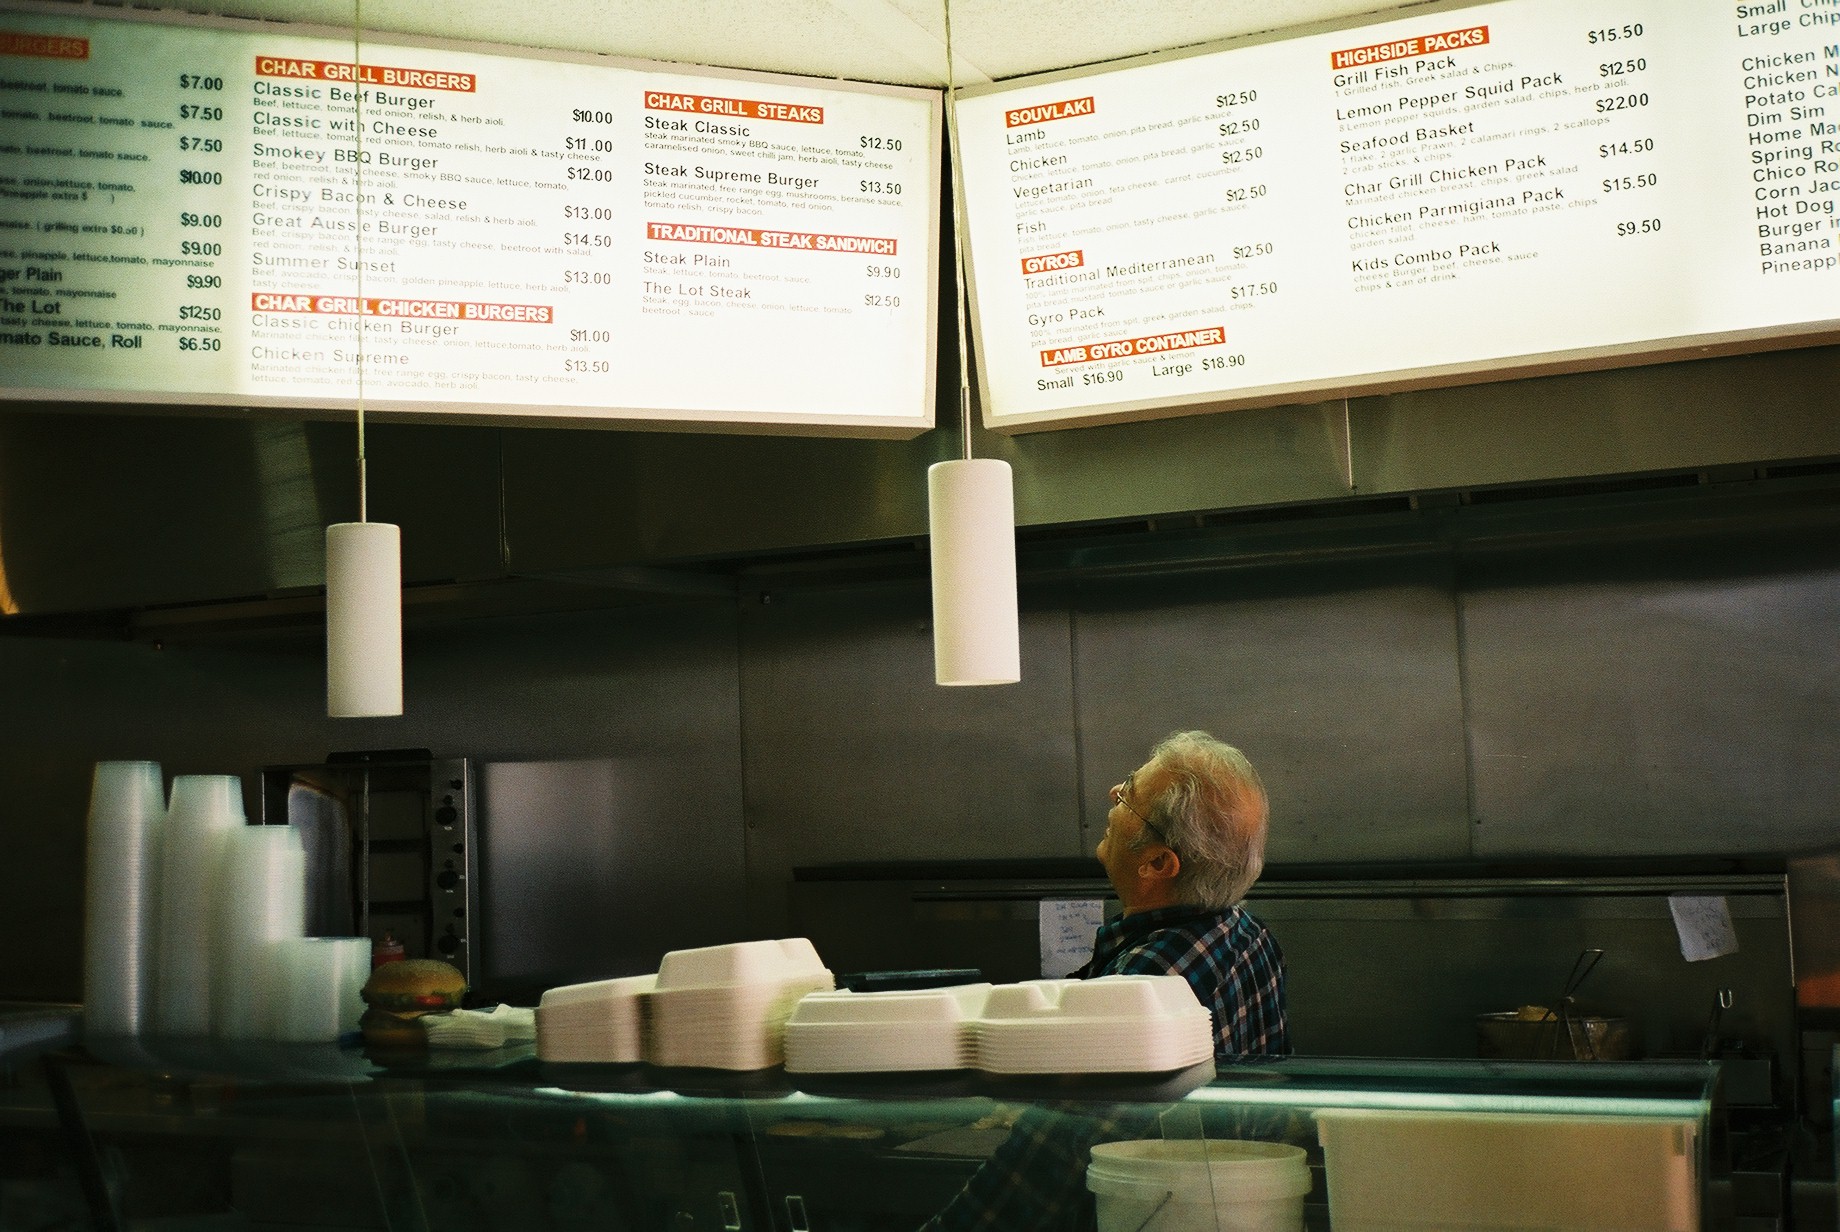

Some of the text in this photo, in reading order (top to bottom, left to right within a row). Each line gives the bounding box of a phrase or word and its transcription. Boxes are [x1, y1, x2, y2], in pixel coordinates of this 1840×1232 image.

[1736, 0, 1786, 19] Small
[1588, 24, 1644, 45] $15.50
[1738, 20, 1791, 37] Large
[1336, 29, 1484, 68] HIGHSIDE PACKS
[1742, 52, 1815, 72] Chicken
[261, 60, 471, 91] CHAR GRILL BURGERS
[1334, 56, 1456, 88] Grill Fish Pack
[1744, 70, 1817, 90] Chicken
[180, 74, 224, 91] $7.00
[254, 81, 435, 110] Classic Beef Burger
[1336, 72, 1564, 121] Lemon Pepper Squid Pack
[1596, 93, 1649, 113] $22.00
[1745, 90, 1805, 109] Potato
[180, 105, 223, 121] $7.50
[573, 109, 613, 124] $10.00
[648, 94, 821, 122] CHAR GRILL STEAKS
[1009, 99, 1092, 125] SOUVLAKI
[1747, 106, 1825, 127] Dim Sim
[254, 112, 321, 130] Classic
[373, 121, 437, 138] Cheese
[644, 117, 750, 137] Steak Classic
[1564, 116, 1610, 129] scallops
[180, 136, 223, 153] $7.50
[671, 135, 716, 144] marinated
[718, 138, 746, 148] smoky
[750, 141, 769, 149] BBQ
[860, 136, 902, 151] $12.50
[1006, 129, 1046, 145] Lamb
[1340, 122, 1474, 154] Seafood Basket
[1749, 128, 1802, 145] Home
[254, 143, 438, 170] Smokey BBQ Burger
[1599, 138, 1654, 159] $14.50
[1751, 146, 1813, 166] Spring
[730, 149, 755, 157] sweet
[799, 155, 818, 164] herb
[842, 159, 862, 169] tasty
[865, 161, 893, 170] cheese
[1010, 154, 1068, 173] Chicken
[568, 167, 613, 183] $12.00
[644, 163, 820, 190] Steak Supreme Burger
[1344, 155, 1546, 197] Char Grill Chicken Pack
[1602, 173, 1657, 193] $15.50
[1754, 166, 1806, 182] Chico
[253, 184, 467, 210] Crispy Bacon & Cheese
[860, 180, 902, 195] $13.50
[1013, 177, 1093, 200] Vegetarian
[1755, 186, 1800, 201] Corn
[564, 205, 612, 221] $13.00
[1348, 187, 1565, 230] Chicken Parmigiana Pack
[1756, 200, 1834, 219] Hot Dog
[181, 212, 222, 228] $9.00
[253, 213, 438, 238] Great Ausse Burger
[1016, 221, 1047, 235] Fish
[1617, 218, 1662, 237] $9.50
[1759, 220, 1821, 238] Burger
[181, 241, 222, 256] $9.00
[564, 233, 612, 248] $14.50
[652, 225, 894, 254] TRADITIONAL STEAK SANDWICH
[1760, 238, 1830, 256] Banana
[152, 258, 215, 268] mayonnaise
[253, 252, 396, 273] Summer Sunset
[644, 251, 730, 268] Steak Plain
[1026, 252, 1080, 273] GYROS
[1351, 241, 1501, 272] Kids Combo Pack
[1762, 252, 1840, 274] Pineapp
[27, 267, 63, 282] Plain
[564, 271, 611, 285] $13.00
[867, 266, 901, 279] $9.90
[1024, 254, 1215, 289] Traditional Mediterranean
[643, 281, 752, 299] The Lot Steak
[1231, 282, 1278, 299] $17.50
[31, 301, 61, 315] Lot
[255, 295, 549, 322] CHAR GRILL CHICKEN BURGERS
[1028, 306, 1105, 328] Gyro Pack
[252, 314, 459, 338] Classic chicken Burger
[49, 332, 142, 349] Sauce, Roll
[179, 337, 221, 352] $6.50
[571, 329, 610, 343] $11.00
[252, 346, 410, 365] Chicken Supreme
[1043, 329, 1222, 366] LAMB GYRO CONTAINER
[565, 359, 609, 373] $13.50
[1037, 355, 1246, 392] Small $16.90 Large $18.90
